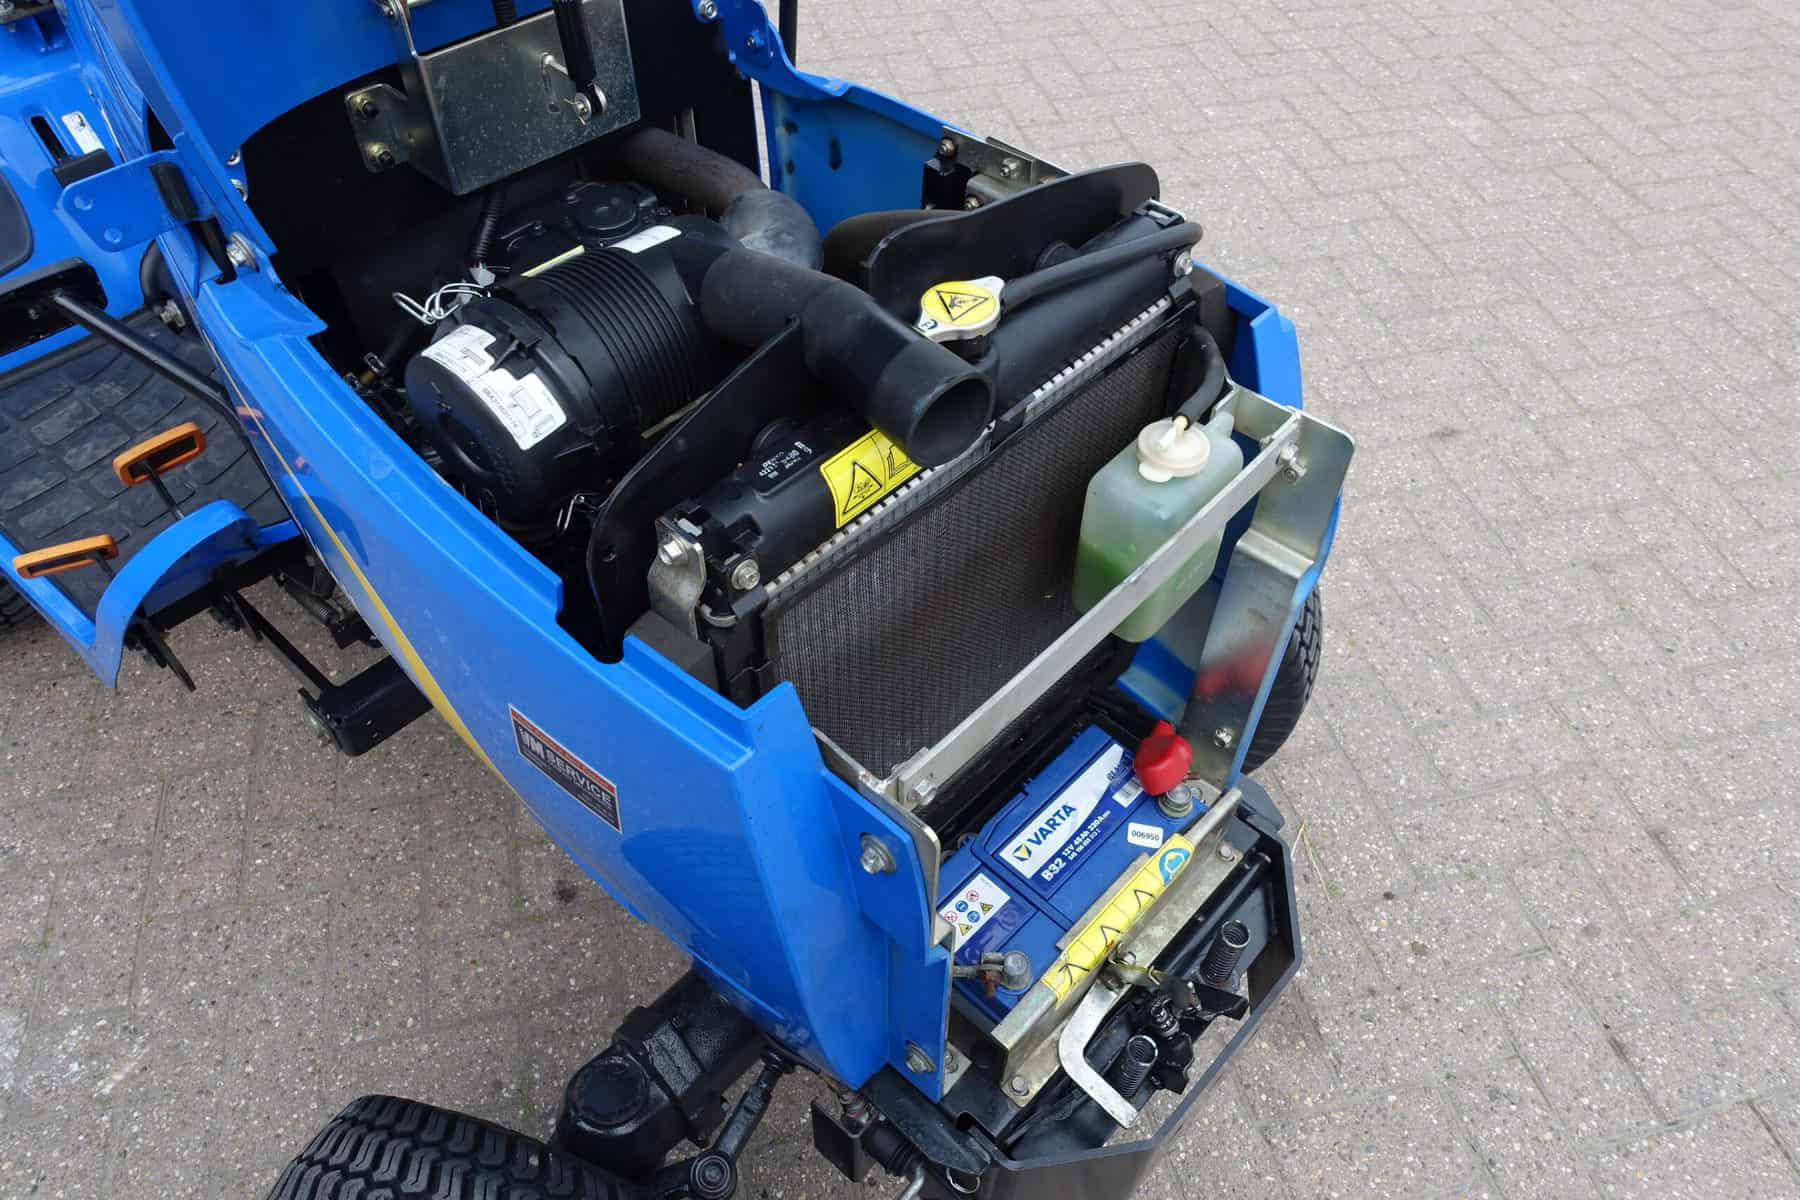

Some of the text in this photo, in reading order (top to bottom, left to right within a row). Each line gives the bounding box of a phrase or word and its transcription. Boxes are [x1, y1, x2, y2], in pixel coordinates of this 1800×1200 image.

[546, 749, 611, 802] SERVICE
[1028, 804, 1077, 846] VARTA
[1041, 858, 1066, 881] B32
